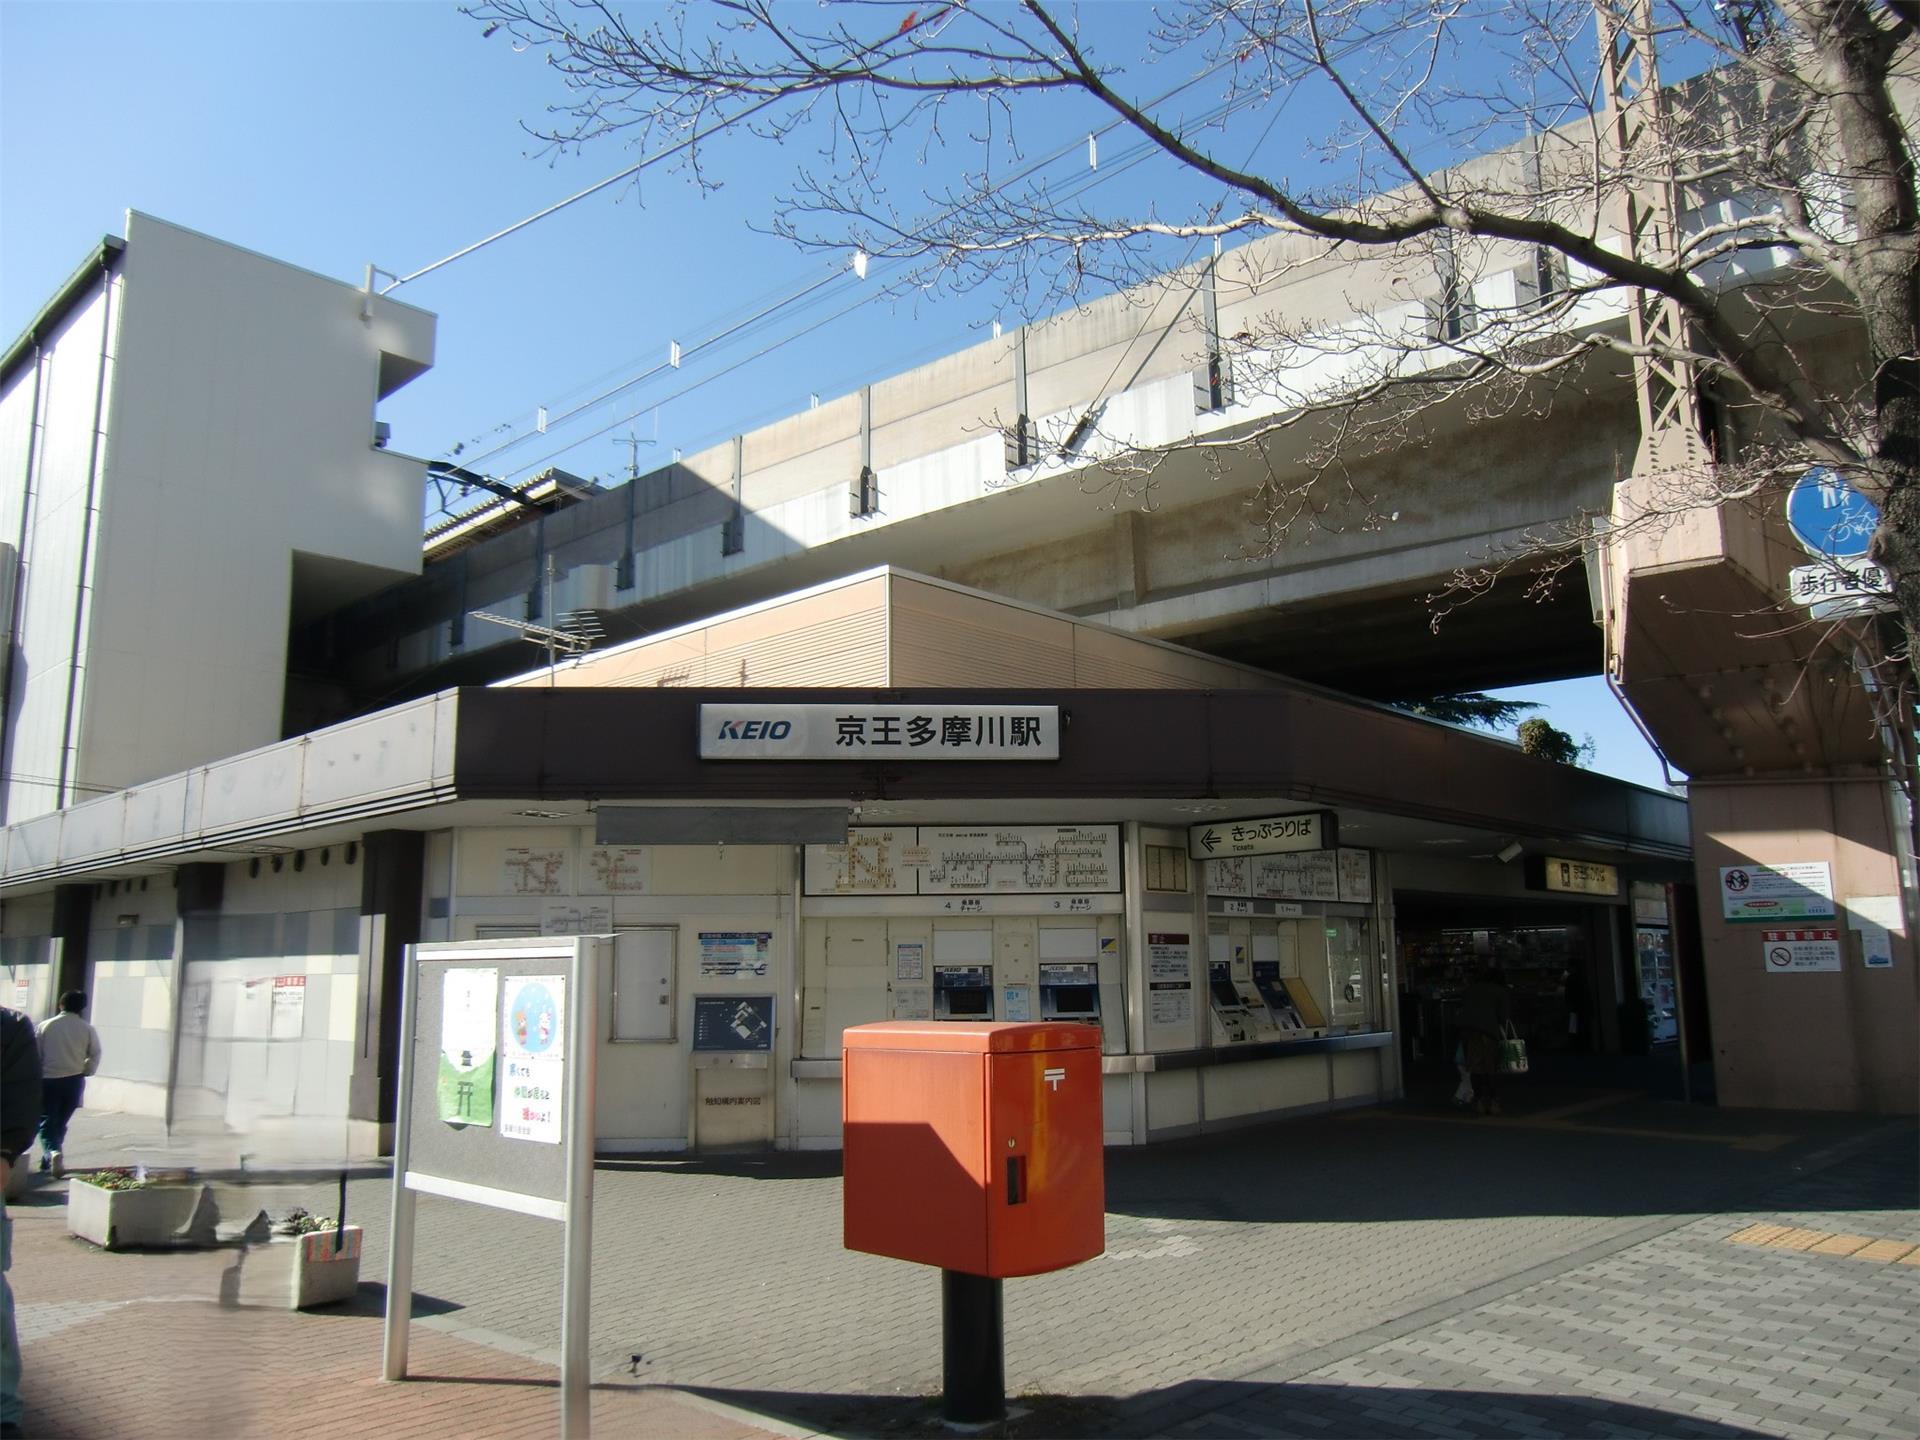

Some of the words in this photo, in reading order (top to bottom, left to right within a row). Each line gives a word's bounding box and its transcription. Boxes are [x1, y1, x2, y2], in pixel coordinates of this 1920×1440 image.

[1800, 567, 1887, 597] 歩行者優
[718, 720, 792, 740] KEIO
[835, 715, 1042, 747] 京王多摩川駅
[1231, 818, 1312, 842] きっぷうりば
[1232, 844, 1254, 852] Tickets
[944, 901, 951, 909] 4
[1053, 900, 1061, 909] 3
